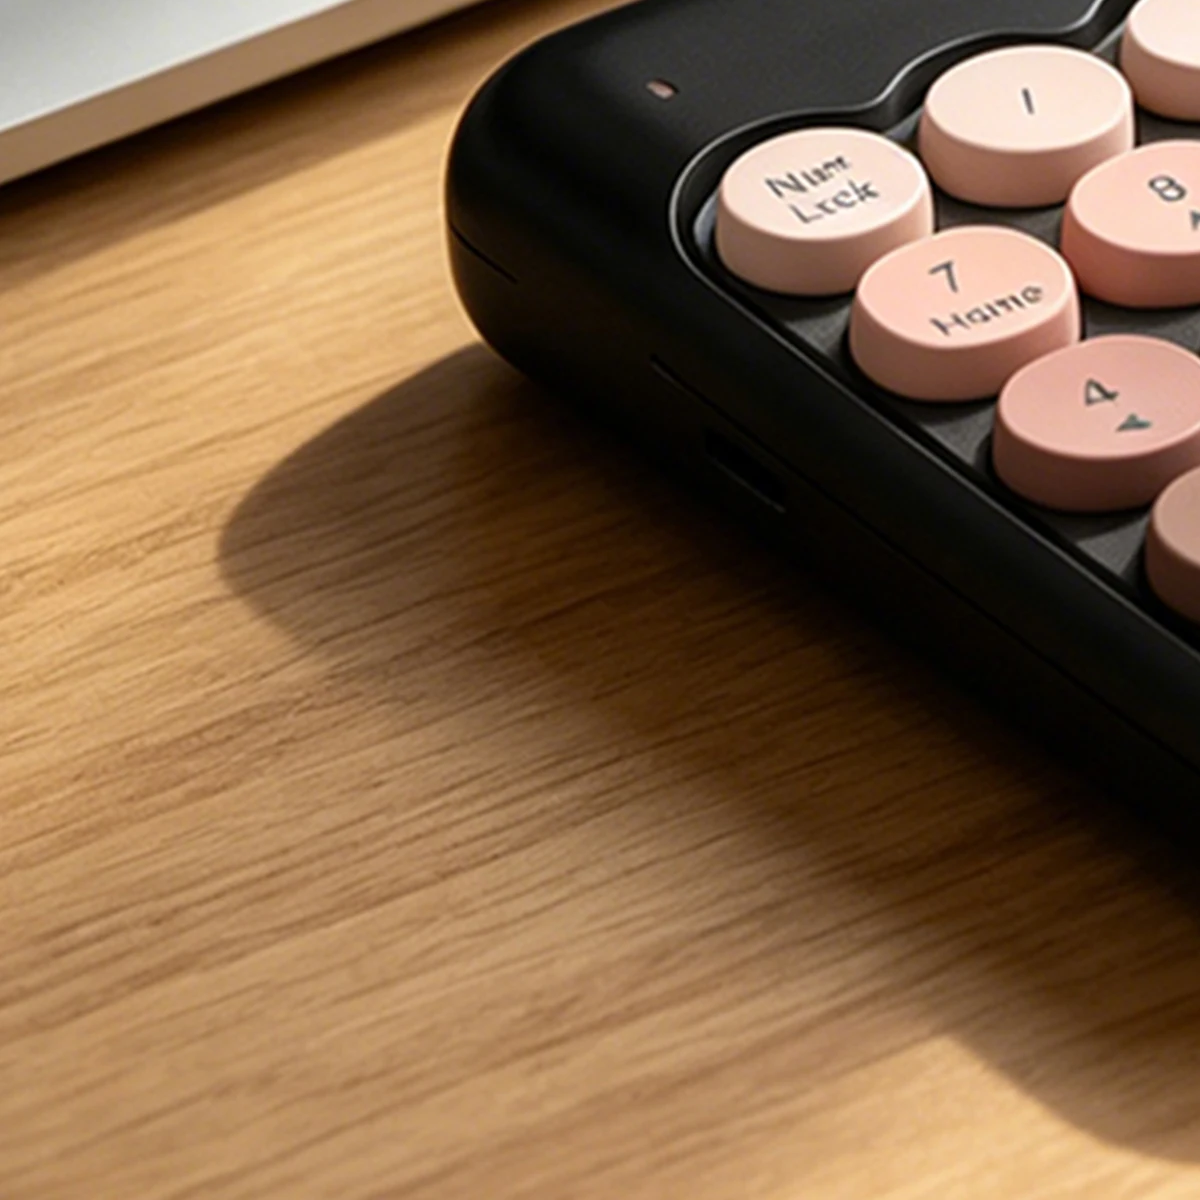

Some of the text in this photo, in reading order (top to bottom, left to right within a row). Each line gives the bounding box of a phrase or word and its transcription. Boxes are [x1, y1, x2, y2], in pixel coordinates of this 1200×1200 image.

[1148, 175, 1187, 202] 8
[928, 259, 958, 293] 7
[1084, 379, 1118, 405] 4
